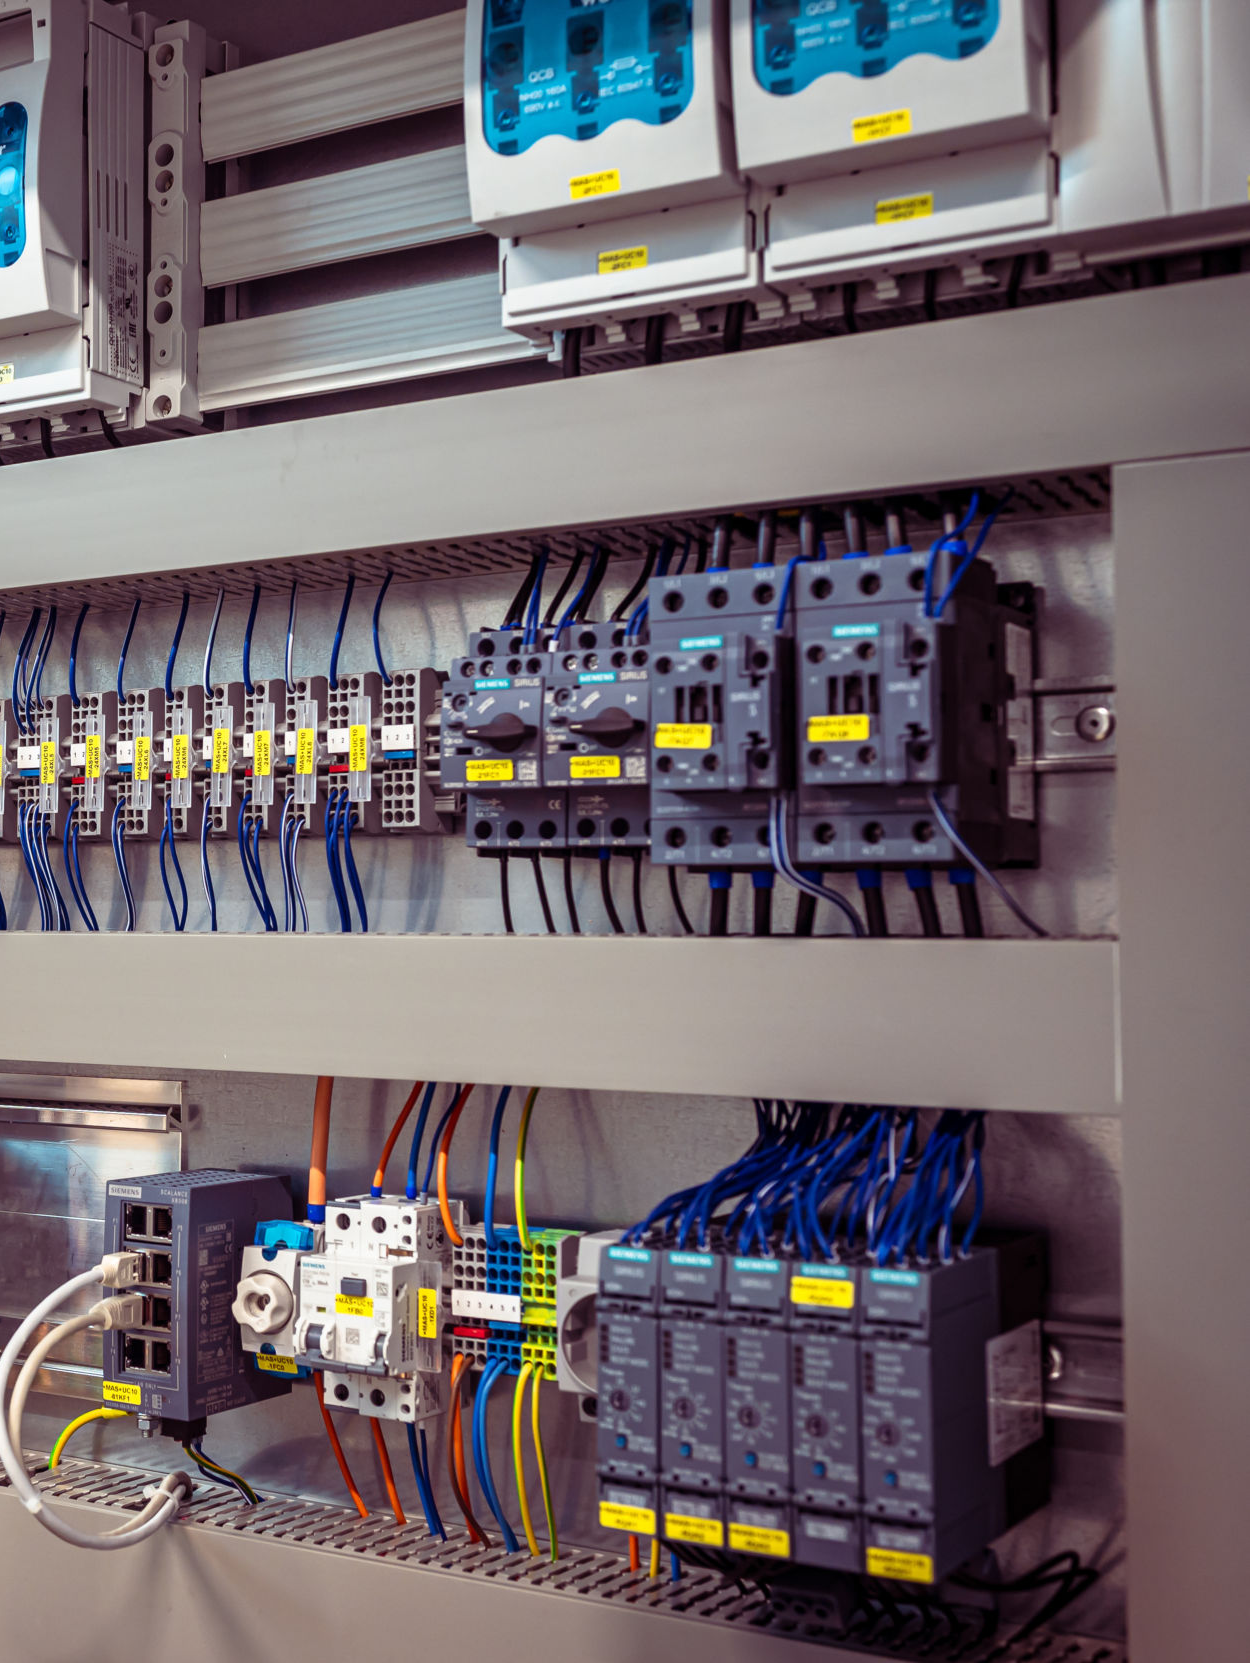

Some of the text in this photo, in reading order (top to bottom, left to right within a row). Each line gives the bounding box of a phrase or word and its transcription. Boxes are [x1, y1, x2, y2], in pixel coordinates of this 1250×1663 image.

[528, 68, 554, 83] QCB
[580, 673, 615, 682] SIEMENS
[476, 678, 540, 688] SIEMENS SIRIUS
[548, 800, 561, 810] CE
[110, 1187, 188, 1197] SIEMENS SCALANCE
[205, 1223, 227, 1233] SIEMENS
